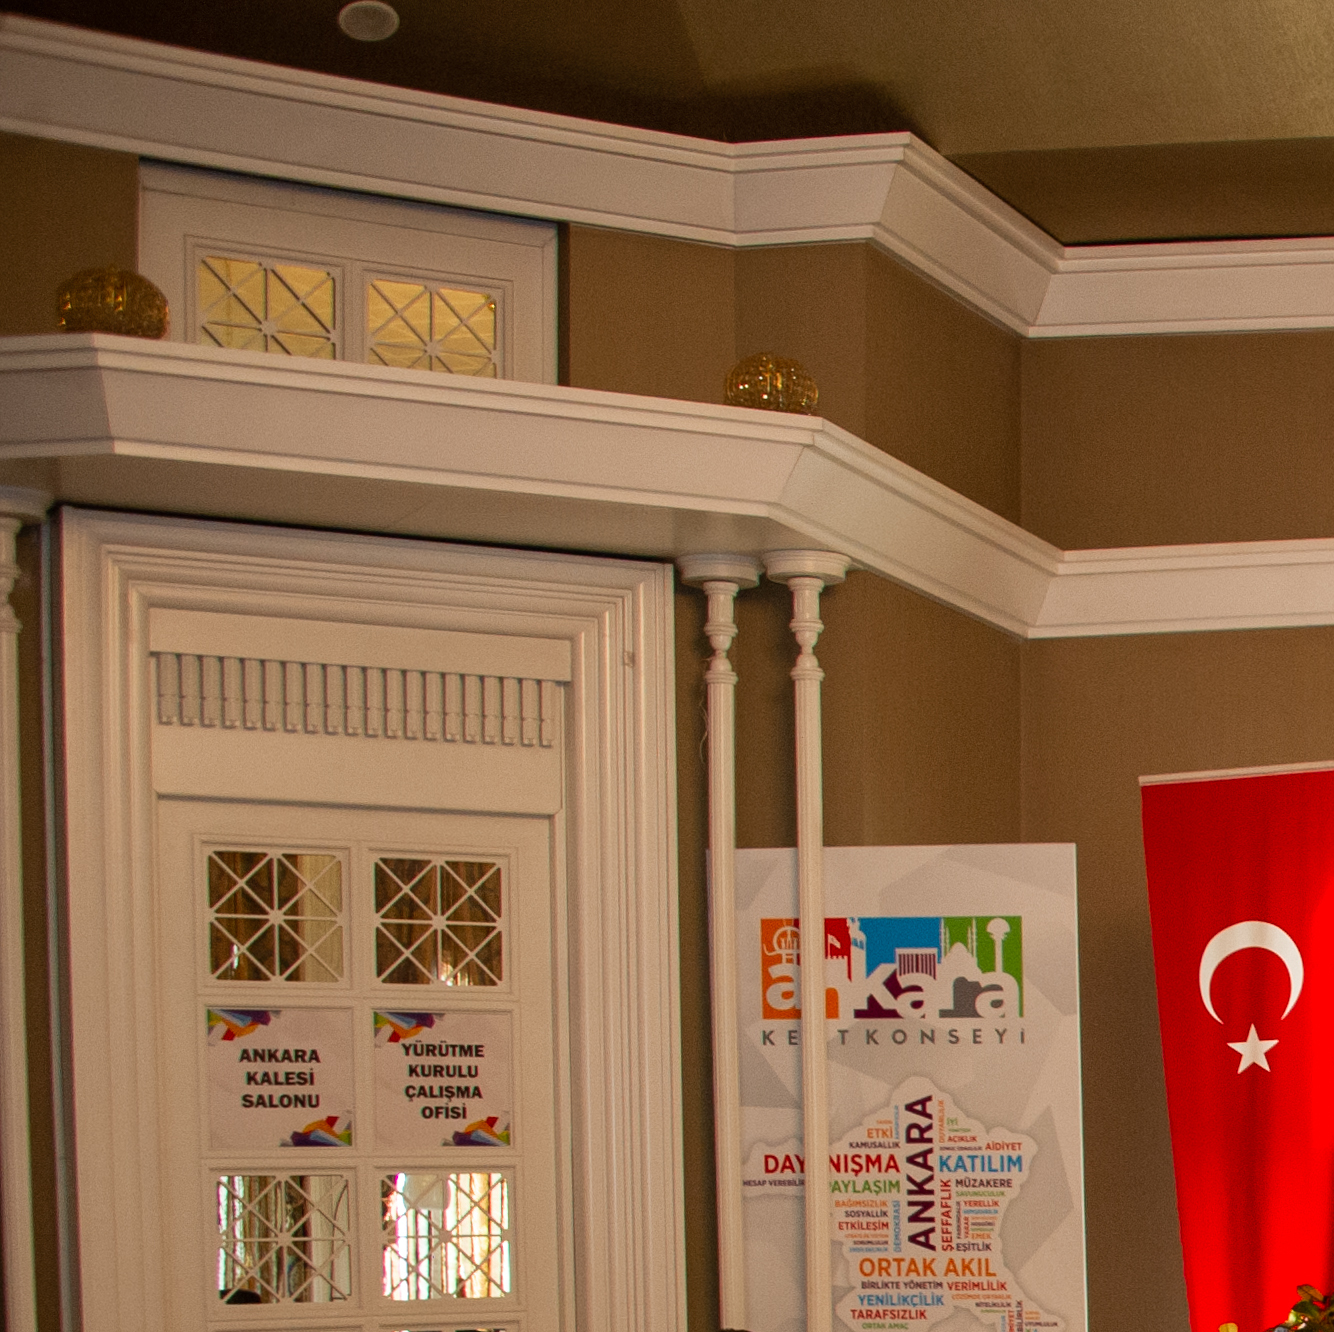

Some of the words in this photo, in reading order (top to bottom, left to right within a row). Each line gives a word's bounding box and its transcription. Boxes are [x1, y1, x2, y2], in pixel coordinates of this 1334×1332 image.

[762, 1029, 848, 1045] KET
[866, 1028, 1025, 1045] KONSEYİ
[239, 1049, 321, 1064] ANKARA
[401, 1040, 485, 1058] YÜRÜTME
[246, 1068, 315, 1087] KALESİ
[408, 1064, 479, 1079] KURULU
[241, 1094, 321, 1109] SALONU
[405, 1085, 483, 1103] ÇALIŞMA
[421, 1103, 467, 1120] OFİSİ
[867, 1127, 893, 1139] ETKİ
[985, 1141, 1022, 1151] AİDİYET
[764, 1154, 901, 1177] DAYNIŞMA
[939, 1155, 1022, 1172] KATILIM
[904, 1095, 936, 1252] ANKARA
[829, 1179, 900, 1196] AYLAŞIM
[956, 1177, 1012, 1188] MÜZAKERE
[940, 1179, 954, 1252] ŞEFFAFLIK
[838, 1220, 889, 1231] ETKİLEŞİM
[956, 1241, 992, 1252] EŞİTLİK
[859, 1257, 937, 1277] ORTAK
[944, 1257, 997, 1277] AKIL
[947, 1280, 1007, 1291] VERİMLİLİK
[858, 1293, 944, 1308] YENİLİKÇİLİK
[851, 1309, 927, 1320] TARAFSIZLIK
